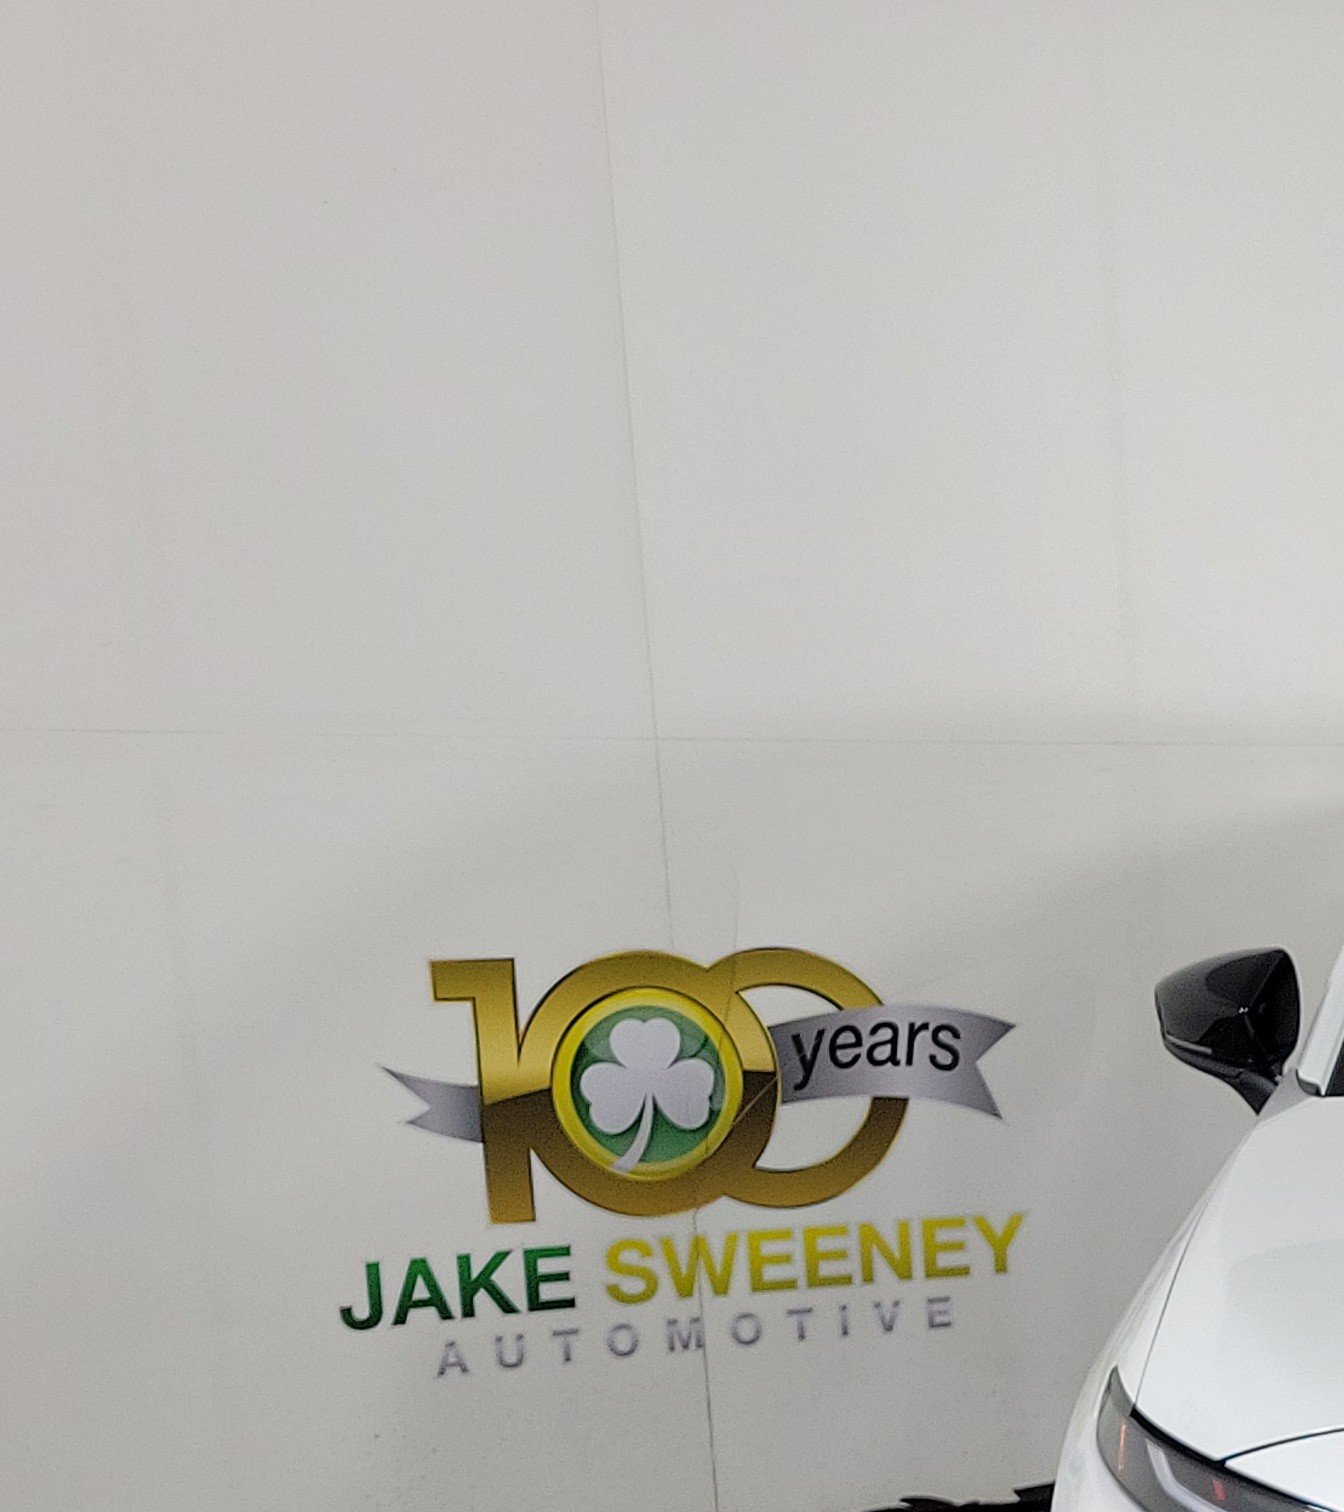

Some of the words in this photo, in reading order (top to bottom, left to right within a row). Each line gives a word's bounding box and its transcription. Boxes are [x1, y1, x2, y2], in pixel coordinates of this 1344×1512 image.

[428, 946, 909, 1225] 100
[790, 1018, 962, 1092] years
[338, 1243, 577, 1333] JAKE
[604, 1210, 1029, 1306] SWEENEY
[435, 1295, 954, 1380] AUTOMOTIVE
